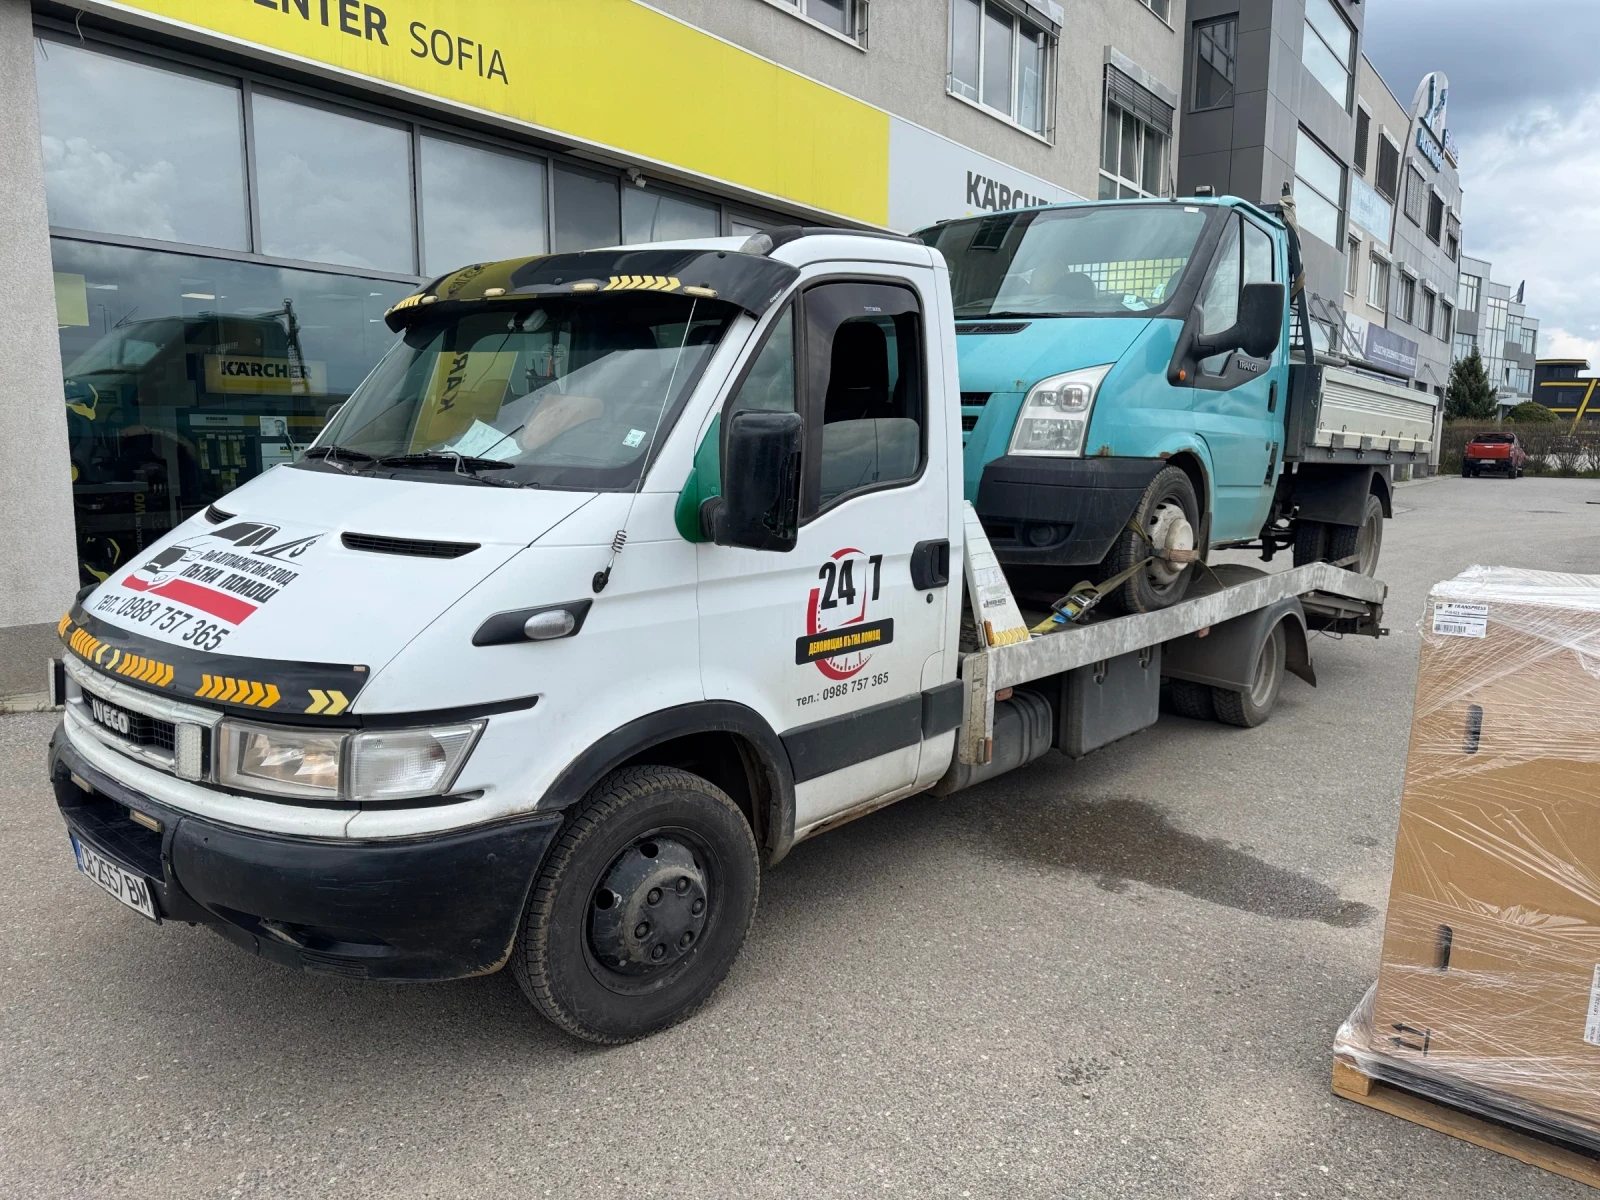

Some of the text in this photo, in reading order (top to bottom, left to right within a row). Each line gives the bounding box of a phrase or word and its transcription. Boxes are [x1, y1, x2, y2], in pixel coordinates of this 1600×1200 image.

[409, 20, 509, 86] SOFIA
[221, 361, 312, 379] KÄRCHR
[179, 563, 225, 584] ПЪТНА
[266, 567, 300, 588] ЕООД
[818, 559, 857, 611] 24
[116, 596, 161, 622] 0988
[150, 606, 195, 634] 757
[182, 619, 231, 652] 365
[843, 633, 860, 648] ПЪТНА
[860, 628, 881, 643] ПОМОЩ
[822, 682, 848, 701] 0988
[851, 677, 869, 693] 757
[871, 671, 889, 688] 365
[92, 699, 130, 734] IVECO
